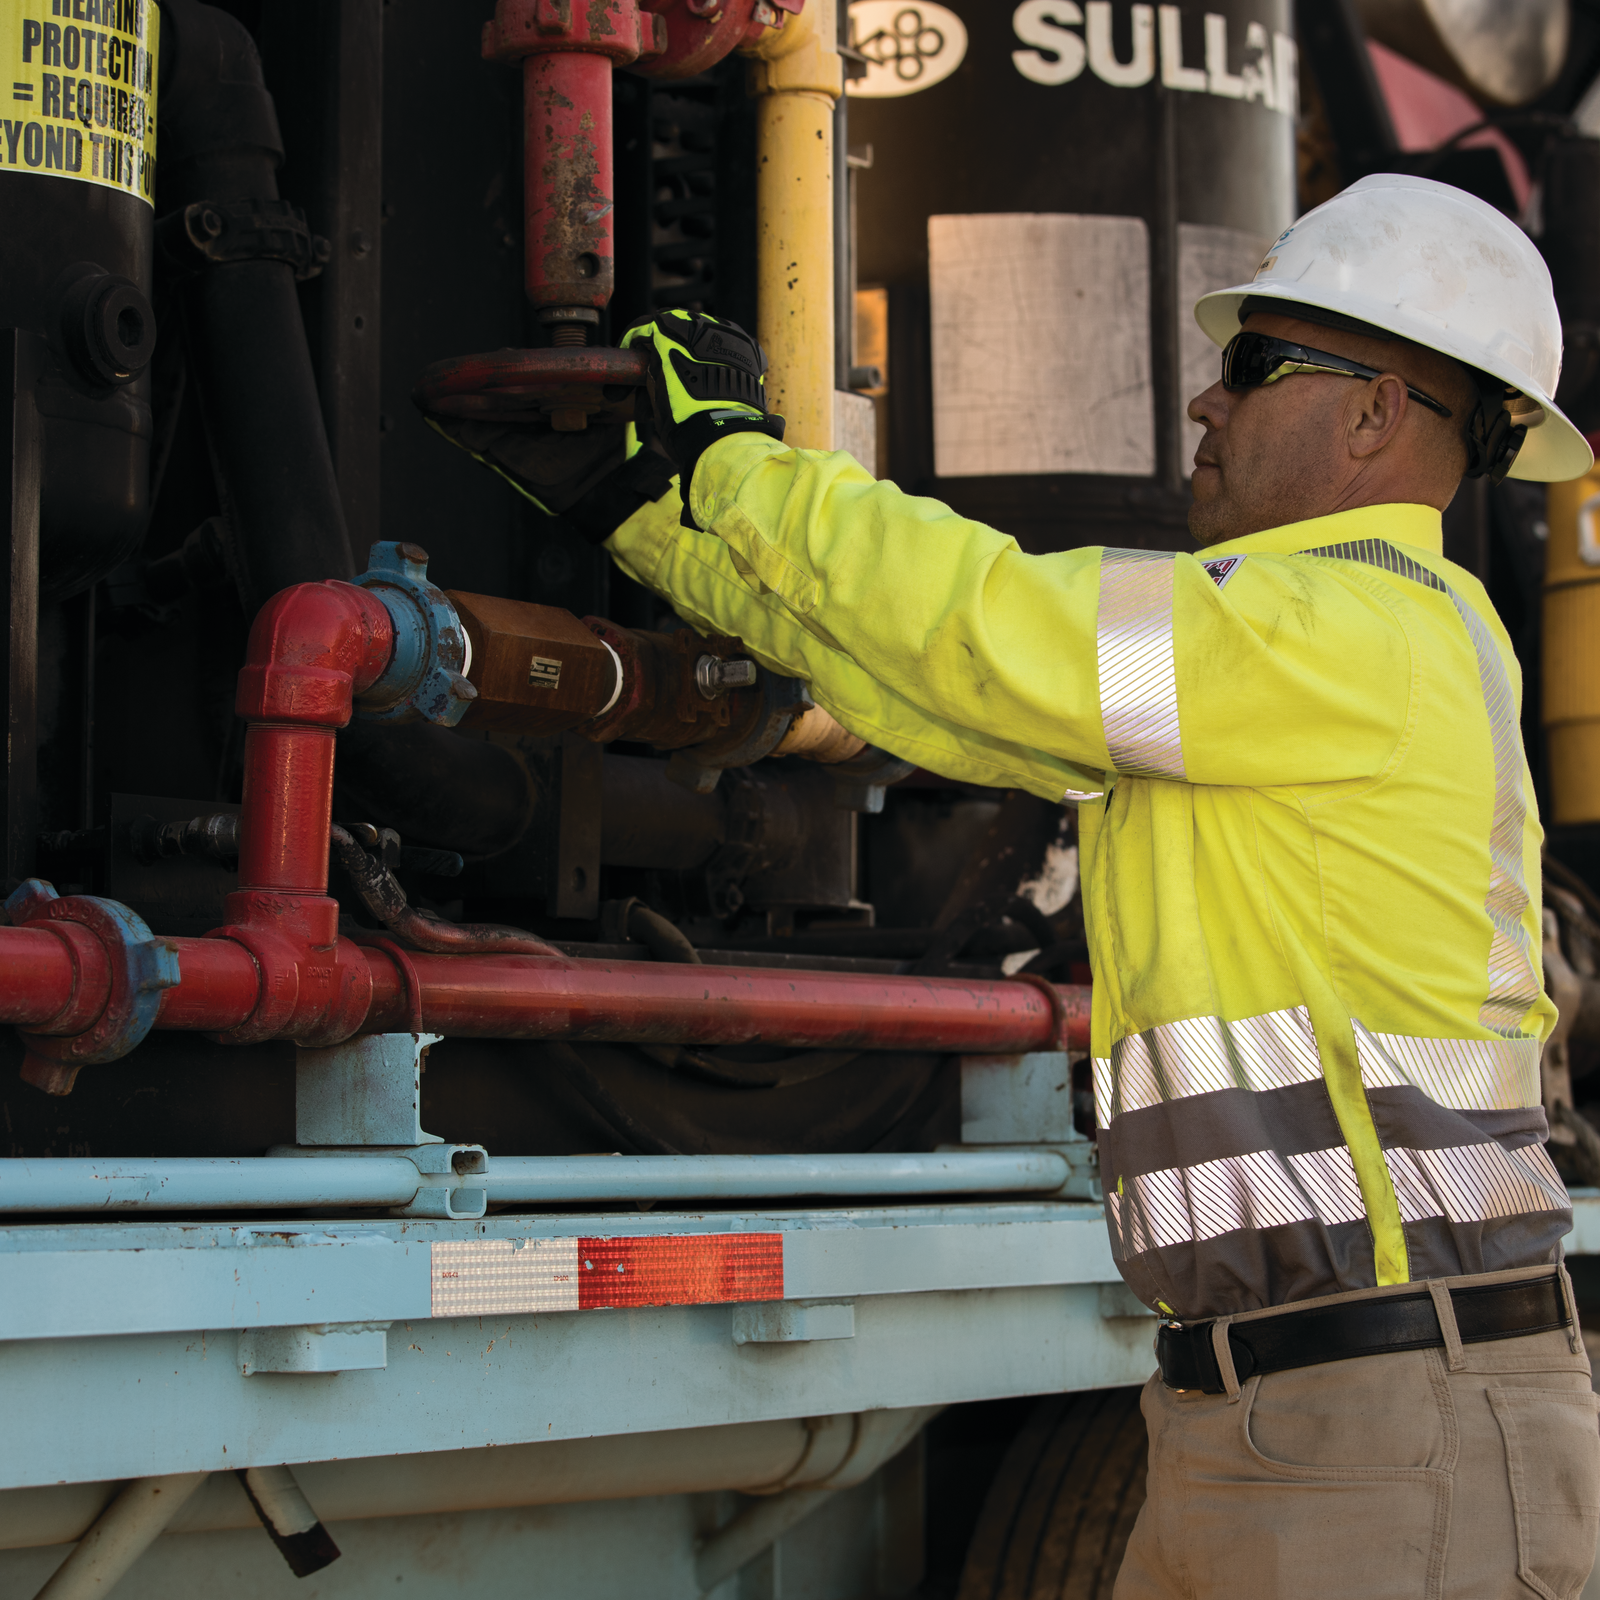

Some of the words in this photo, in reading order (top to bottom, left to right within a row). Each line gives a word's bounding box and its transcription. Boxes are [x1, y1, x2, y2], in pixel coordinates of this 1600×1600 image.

[23, 19, 152, 95] PROTECTION
[42, 73, 144, 140] REQUIRED
[0, 120, 83, 172] YOND
[90, 132, 133, 187] THIS
